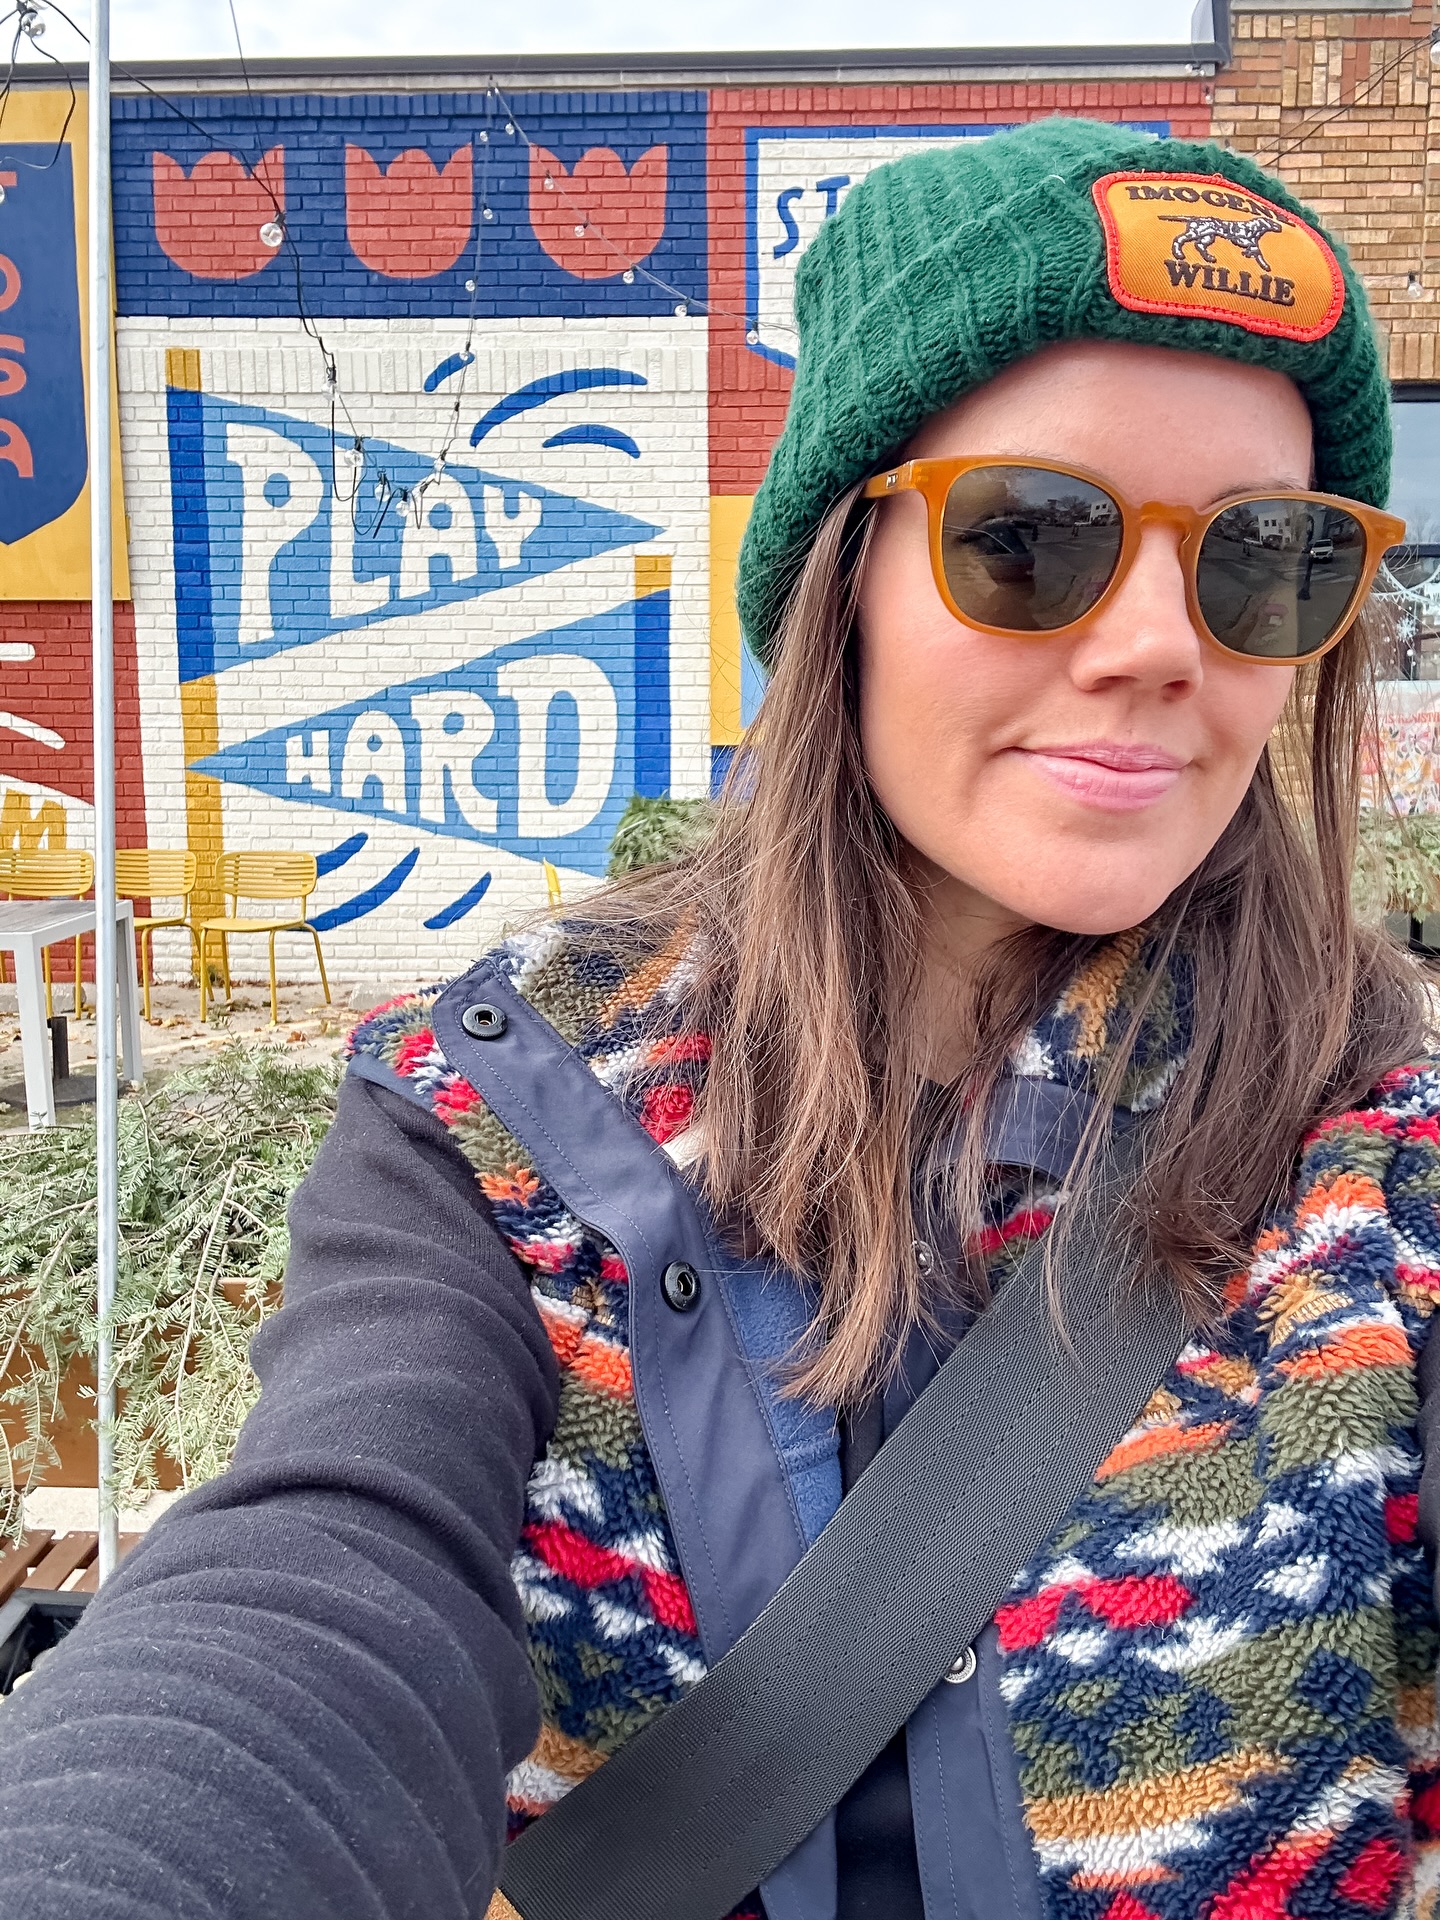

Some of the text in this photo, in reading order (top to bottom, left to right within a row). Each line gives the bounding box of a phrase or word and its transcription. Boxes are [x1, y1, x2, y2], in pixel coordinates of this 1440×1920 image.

[1164, 259, 1296, 306] WILLIE
[226, 423, 543, 645] PLAY
[285, 653, 618, 838] HARD
